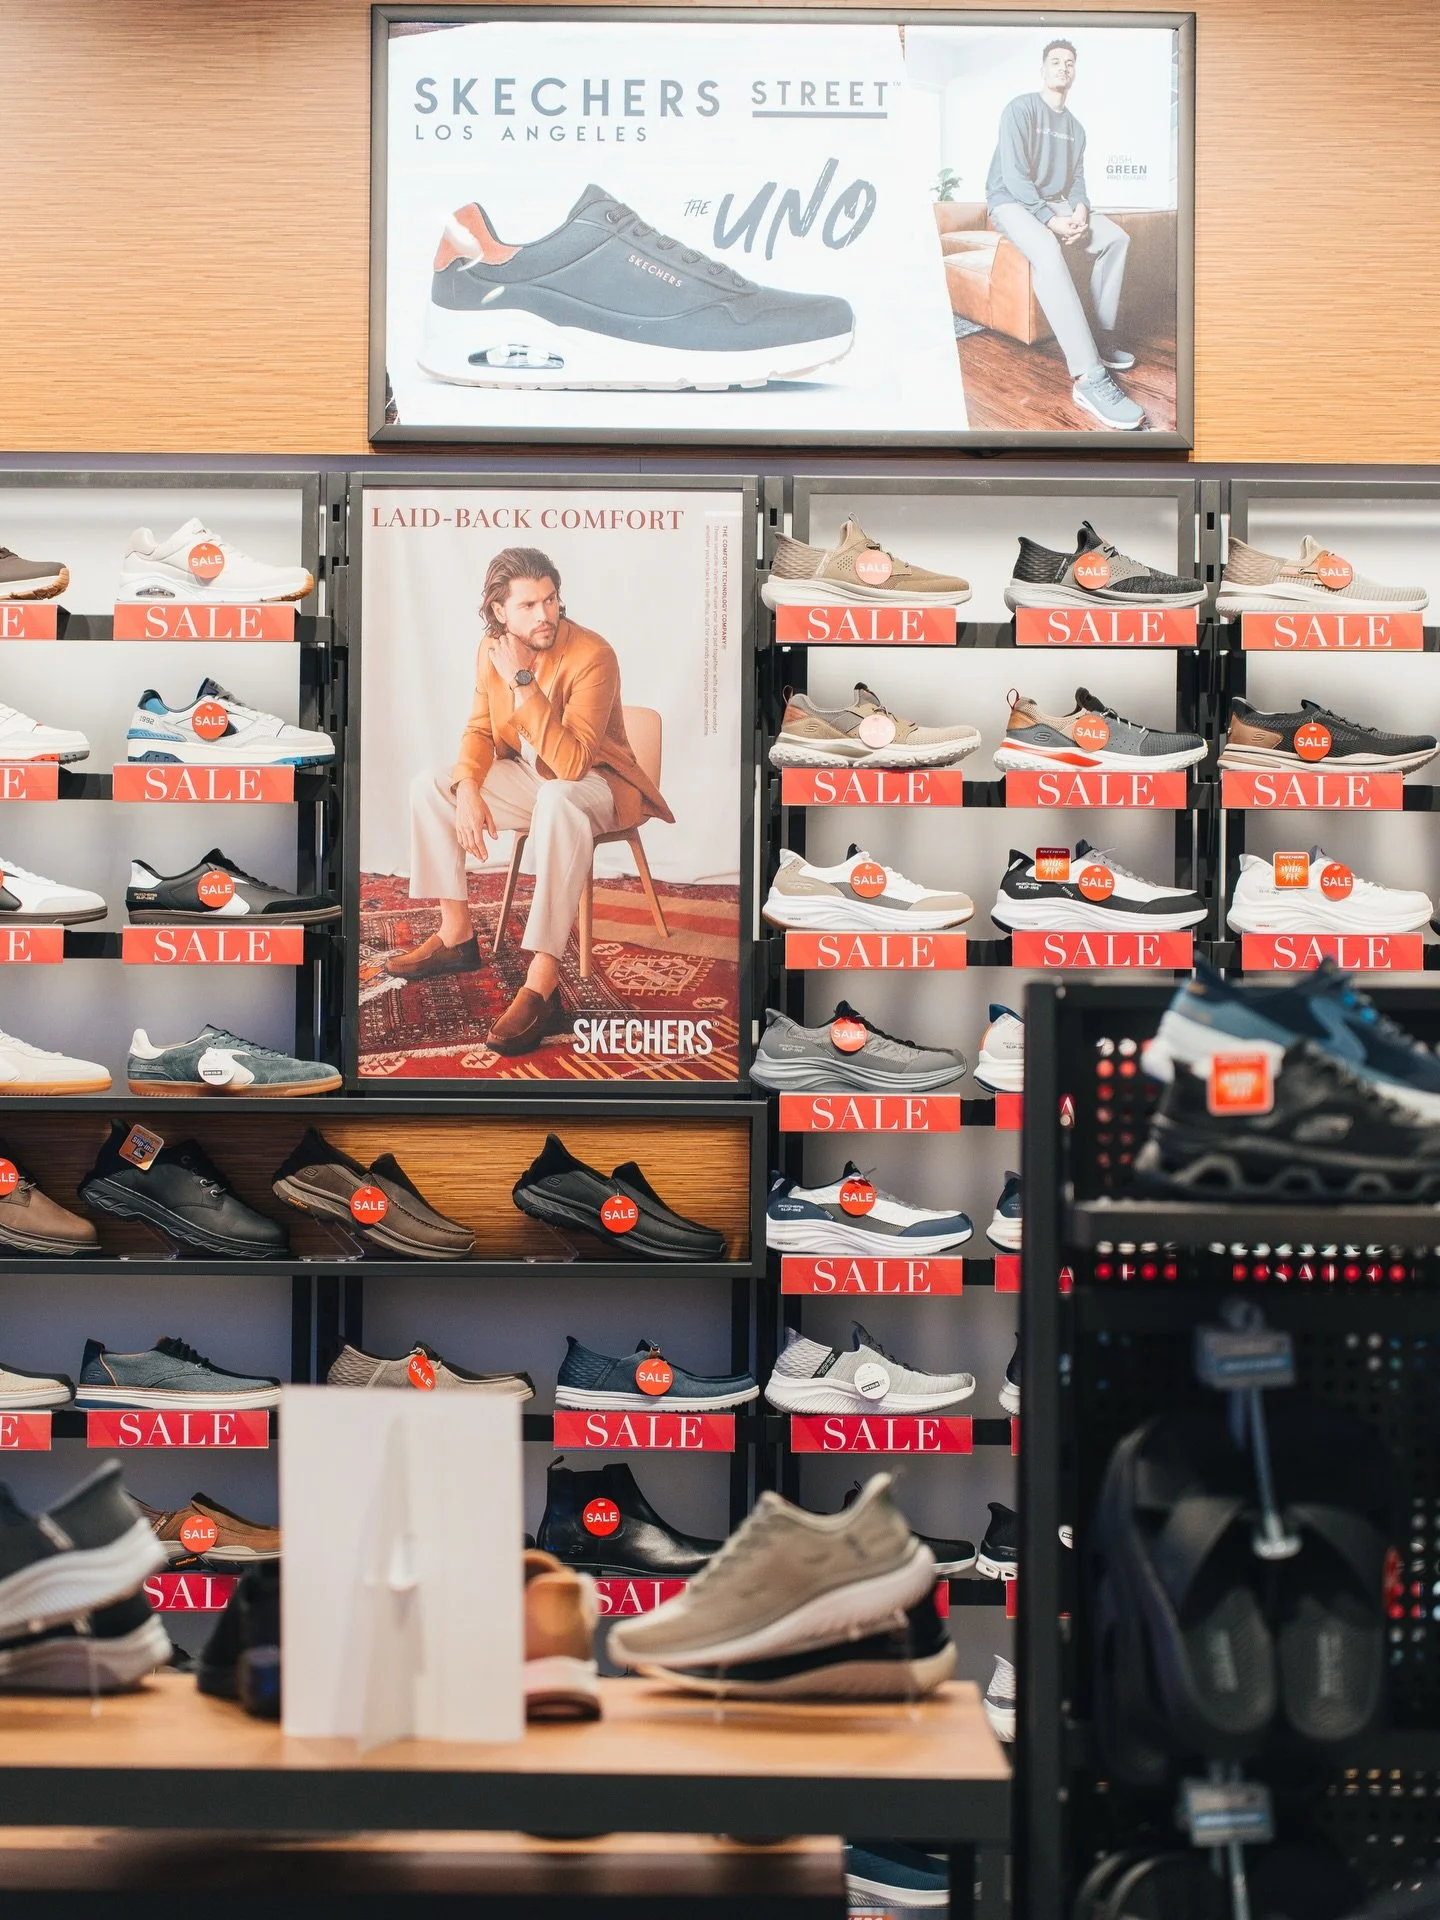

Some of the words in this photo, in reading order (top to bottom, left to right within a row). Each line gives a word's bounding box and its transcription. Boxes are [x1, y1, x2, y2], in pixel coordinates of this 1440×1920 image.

[414, 77, 721, 117] SKECHERS
[415, 124, 474, 142] LOS
[501, 125, 648, 143] ANGELES
[1106, 165, 1148, 174] GREEN
[683, 198, 713, 218] THE
[712, 157, 878, 261] UNO
[628, 254, 683, 288] SKECHERS
[371, 507, 532, 530] LAID-BACK
[540, 508, 686, 531] COMFORT
[192, 554, 223, 567] SALE
[859, 563, 890, 573] SALE
[1077, 566, 1109, 577] SALE
[1319, 567, 1350, 577] SALE
[145, 606, 263, 638] SALE
[807, 608, 925, 641] SALE
[1048, 610, 1165, 643] SALE
[1274, 616, 1392, 647] SALE
[195, 716, 226, 726] SALE
[1076, 727, 1107, 739] SALE
[1297, 736, 1329, 748] SALE
[144, 768, 262, 800] SALE
[813, 771, 931, 803] SALE
[1037, 774, 1155, 806] SALE
[1253, 775, 1371, 807] SALE
[1042, 859, 1063, 867] WIDE
[1281, 865, 1304, 873] WIDE
[853, 875, 885, 885] SALE
[1081, 877, 1113, 889] SALE
[1285, 872, 1299, 881] FIT
[1322, 877, 1352, 887] SALE
[201, 884, 232, 895] SALE
[154, 930, 271, 962] SALE
[817, 935, 935, 967] SALE
[1043, 934, 1161, 966] SALE
[1273, 937, 1391, 969] SALE
[834, 1029, 865, 1040] SALE
[811, 1098, 929, 1130] SALE
[0, 1173, 16, 1183] LE
[353, 1200, 385, 1211] SALE
[842, 1192, 874, 1203] SALE
[603, 1208, 636, 1221] SALE
[813, 1260, 931, 1293] SALE
[411, 1360, 433, 1388] SALE
[639, 1371, 670, 1383] SALE
[118, 1413, 237, 1446] SALE
[585, 1414, 703, 1448] SALE
[823, 1418, 941, 1451] SALE
[586, 1510, 618, 1523] SALE
[183, 1529, 216, 1539] SALE
[142, 1575, 241, 1609] SAL
[593, 1580, 691, 1614] SAL
